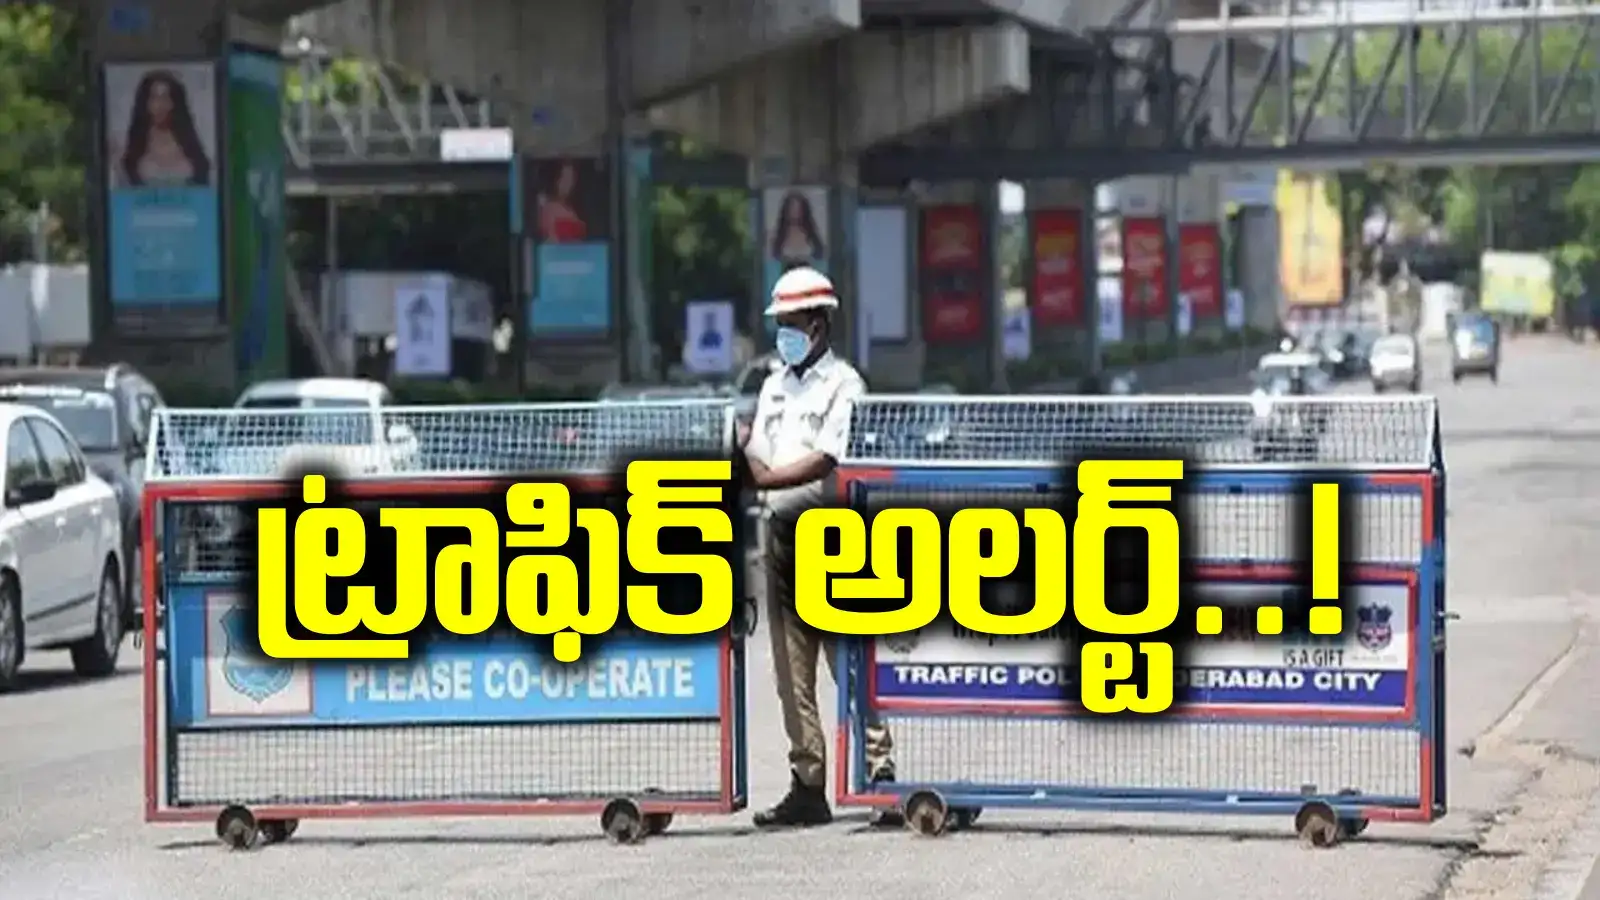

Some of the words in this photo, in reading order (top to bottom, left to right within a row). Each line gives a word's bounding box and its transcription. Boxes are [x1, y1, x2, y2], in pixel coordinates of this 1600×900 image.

[1312, 648, 1344, 666] GIFT
[346, 662, 473, 701] PLEASE
[484, 658, 695, 699] CO-OPERATE
[894, 666, 1008, 685] TRAFFIC
[1017, 666, 1073, 686] POL
[1314, 672, 1381, 691] CITY
